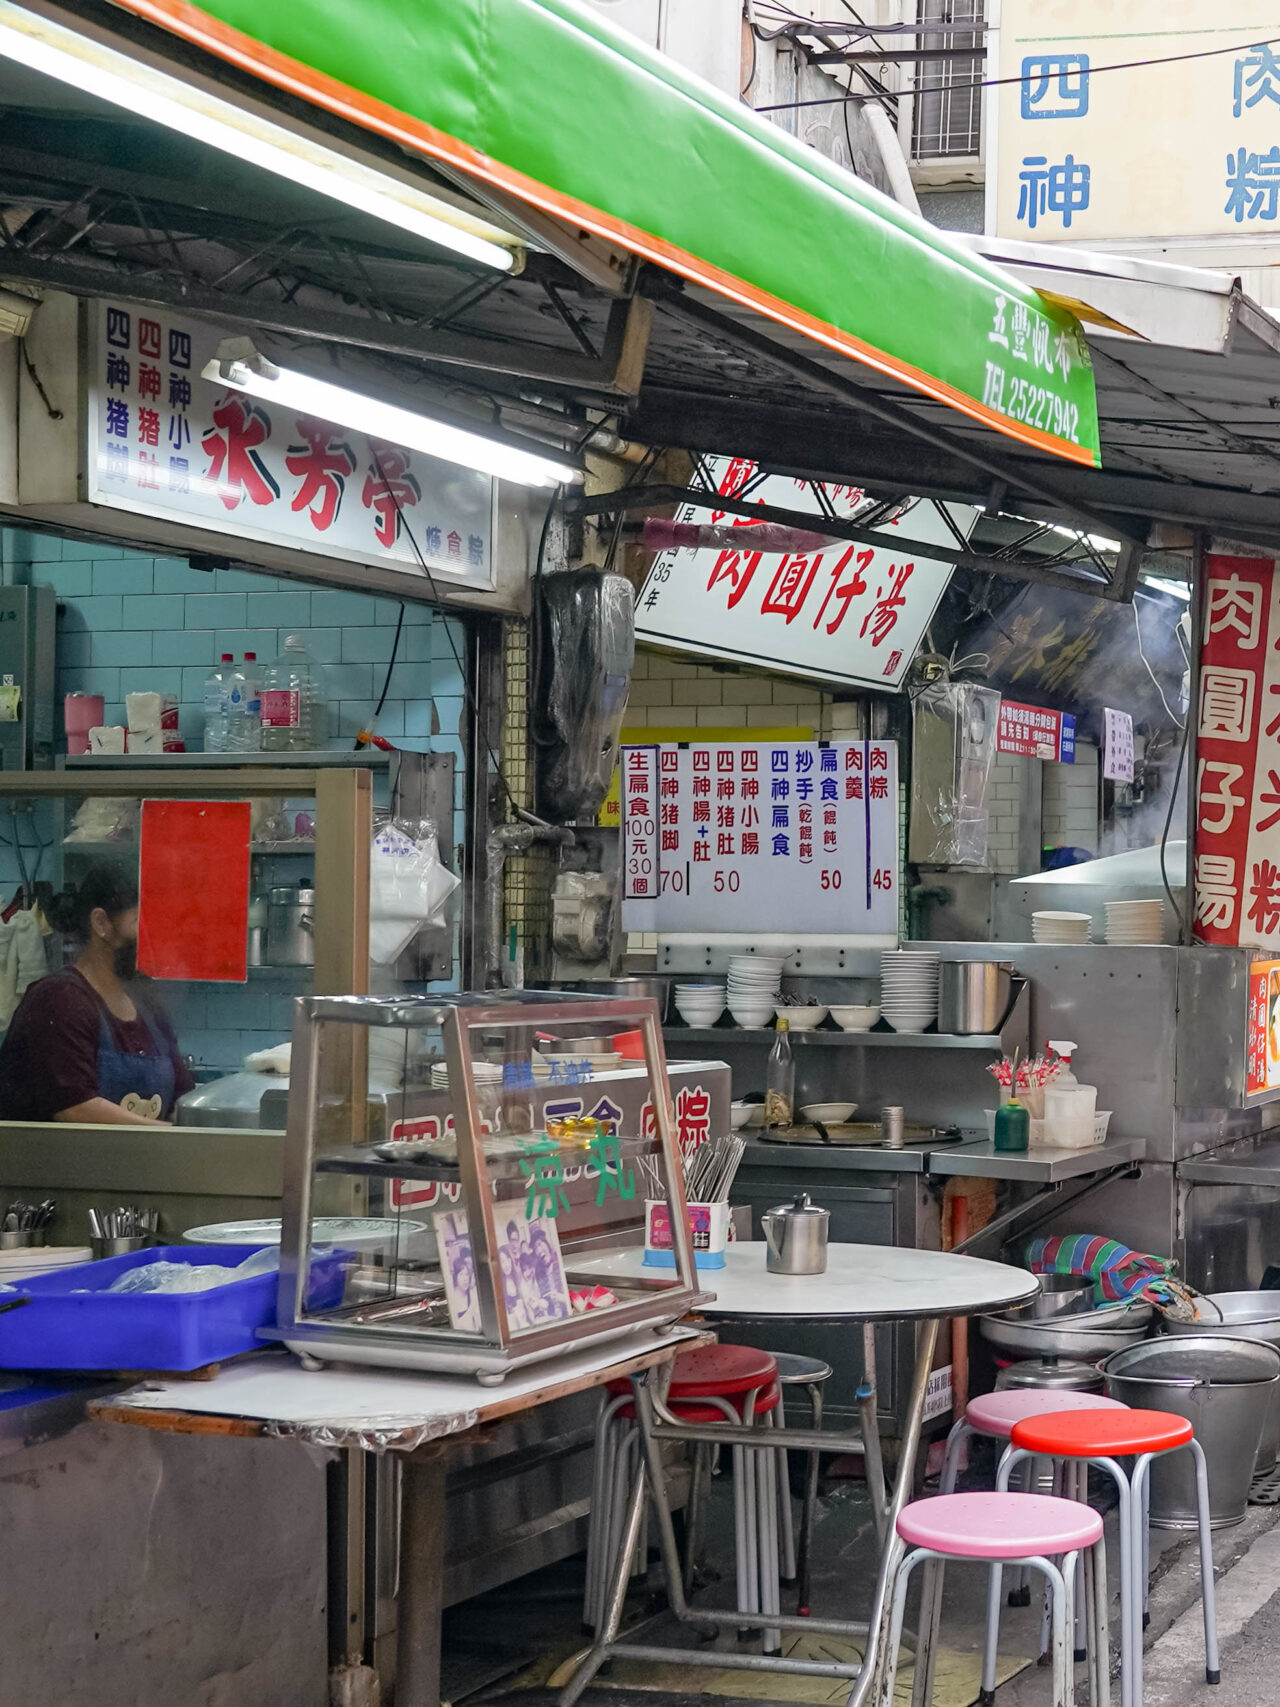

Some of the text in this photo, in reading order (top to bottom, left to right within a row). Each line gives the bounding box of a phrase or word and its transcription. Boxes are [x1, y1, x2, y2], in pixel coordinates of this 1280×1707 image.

[1017, 53, 1091, 228] 四神
[982, 360, 1079, 444] TEL 25227942
[845, 748, 863, 800] 肉羹
[870, 747, 889, 799] 肉粽
[740, 750, 760, 856] 四神小腸
[771, 750, 791, 857] 四神扁食
[660, 870, 683, 893] 70
[713, 870, 741, 893] 50
[820, 869, 843, 890] 50
[873, 868, 893, 890] 45
